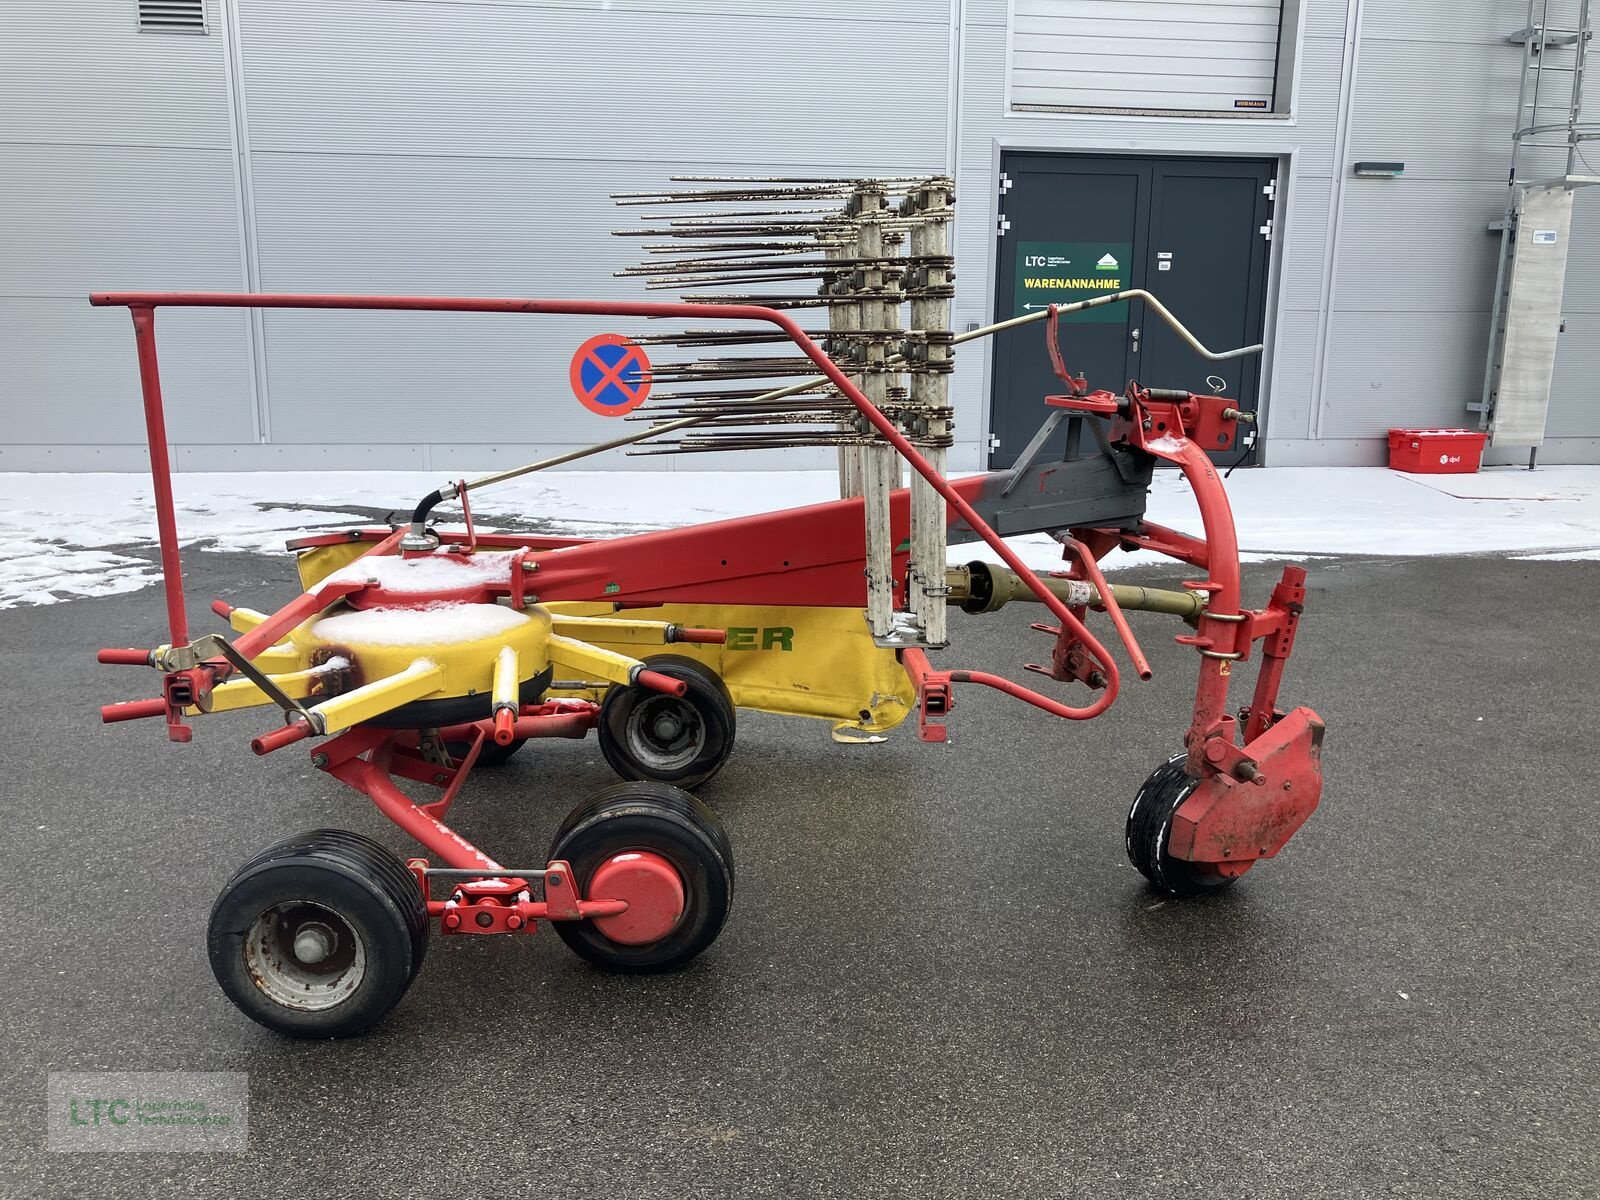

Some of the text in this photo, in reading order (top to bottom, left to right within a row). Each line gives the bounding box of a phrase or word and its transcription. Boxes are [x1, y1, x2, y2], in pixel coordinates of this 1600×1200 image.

[1025, 255, 1046, 267] LTC
[1024, 278, 1121, 289] WARENANNAHME
[1449, 456, 1460, 464] dpd
